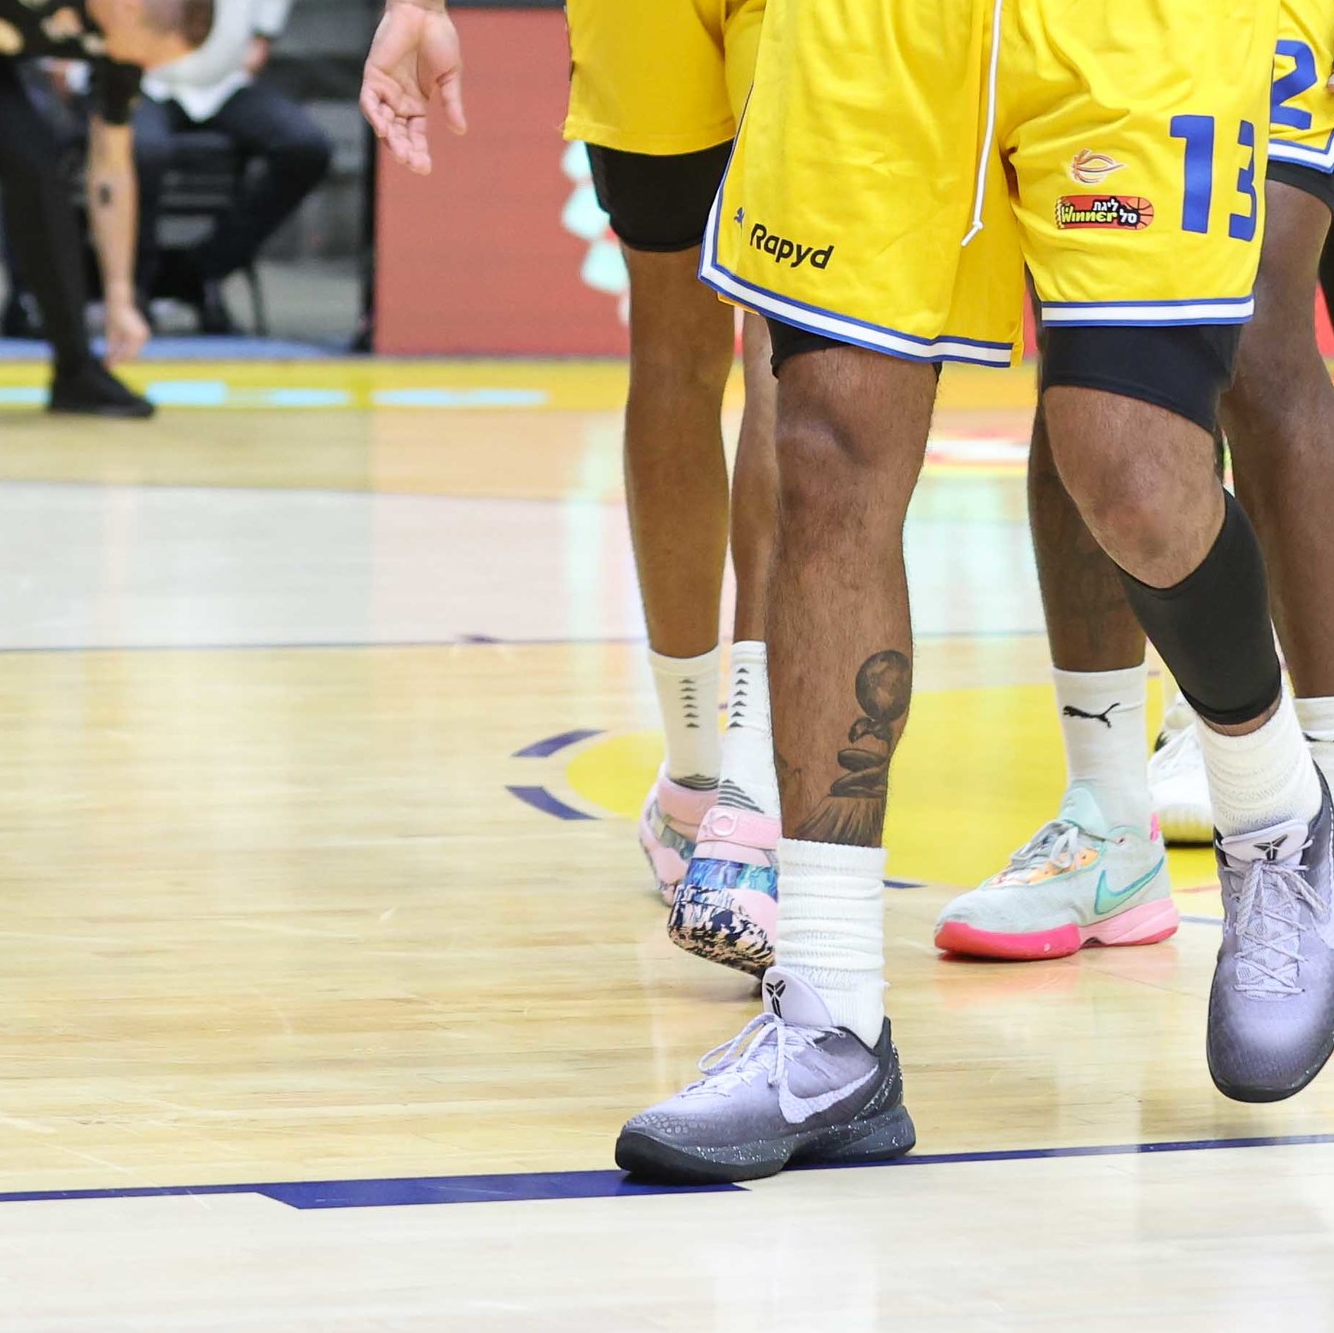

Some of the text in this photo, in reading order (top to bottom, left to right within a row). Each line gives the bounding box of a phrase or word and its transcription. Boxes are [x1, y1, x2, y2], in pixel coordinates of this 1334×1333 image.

[1170, 114, 1255, 242] 13
[1061, 205, 1118, 223] Winner
[750, 223, 835, 269] Rapyd
